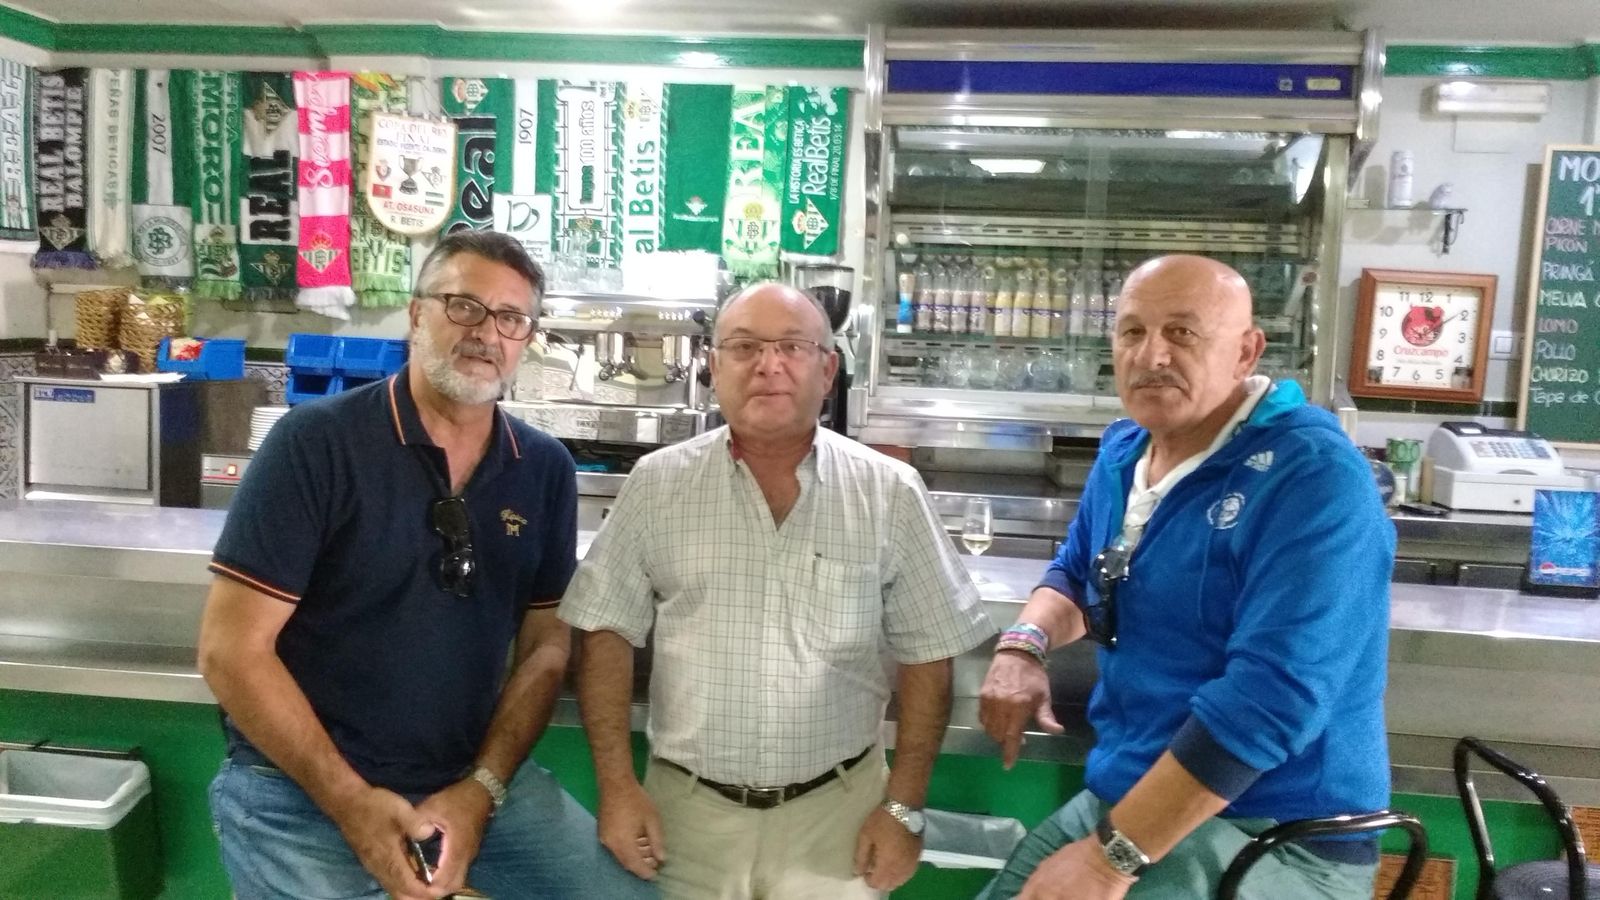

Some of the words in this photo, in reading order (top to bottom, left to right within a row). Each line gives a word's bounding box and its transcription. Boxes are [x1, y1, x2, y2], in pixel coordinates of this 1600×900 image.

[38, 74, 65, 142] BETIS
[578, 100, 595, 136] años
[518, 108, 533, 144] 1907
[151, 112, 167, 155] 2007
[65, 87, 83, 208] BALOMPIE
[39, 149, 65, 212] REAL
[629, 139, 655, 216] Betis
[790, 158, 802, 193] HISTORIA
[249, 149, 291, 242] REAL
[790, 193, 800, 204] LA
[401, 217, 425, 228] BETIS
[1399, 291, 1410, 302] 11
[1419, 291, 1434, 303] 12
[1446, 293, 1452, 304] 1
[1538, 289, 1588, 308] MELVA
[1379, 305, 1394, 318] 10
[1460, 309, 1469, 321] 2
[1536, 318, 1579, 334] LOMO
[1379, 328, 1388, 339] 9
[1457, 332, 1466, 343] 3
[1375, 349, 1385, 361] 8
[1393, 344, 1449, 358] Cruzcampo
[1454, 355, 1463, 365] 4
[1392, 366, 1401, 378] 7
[1412, 370, 1421, 381] 6
[1434, 368, 1444, 380] 5
